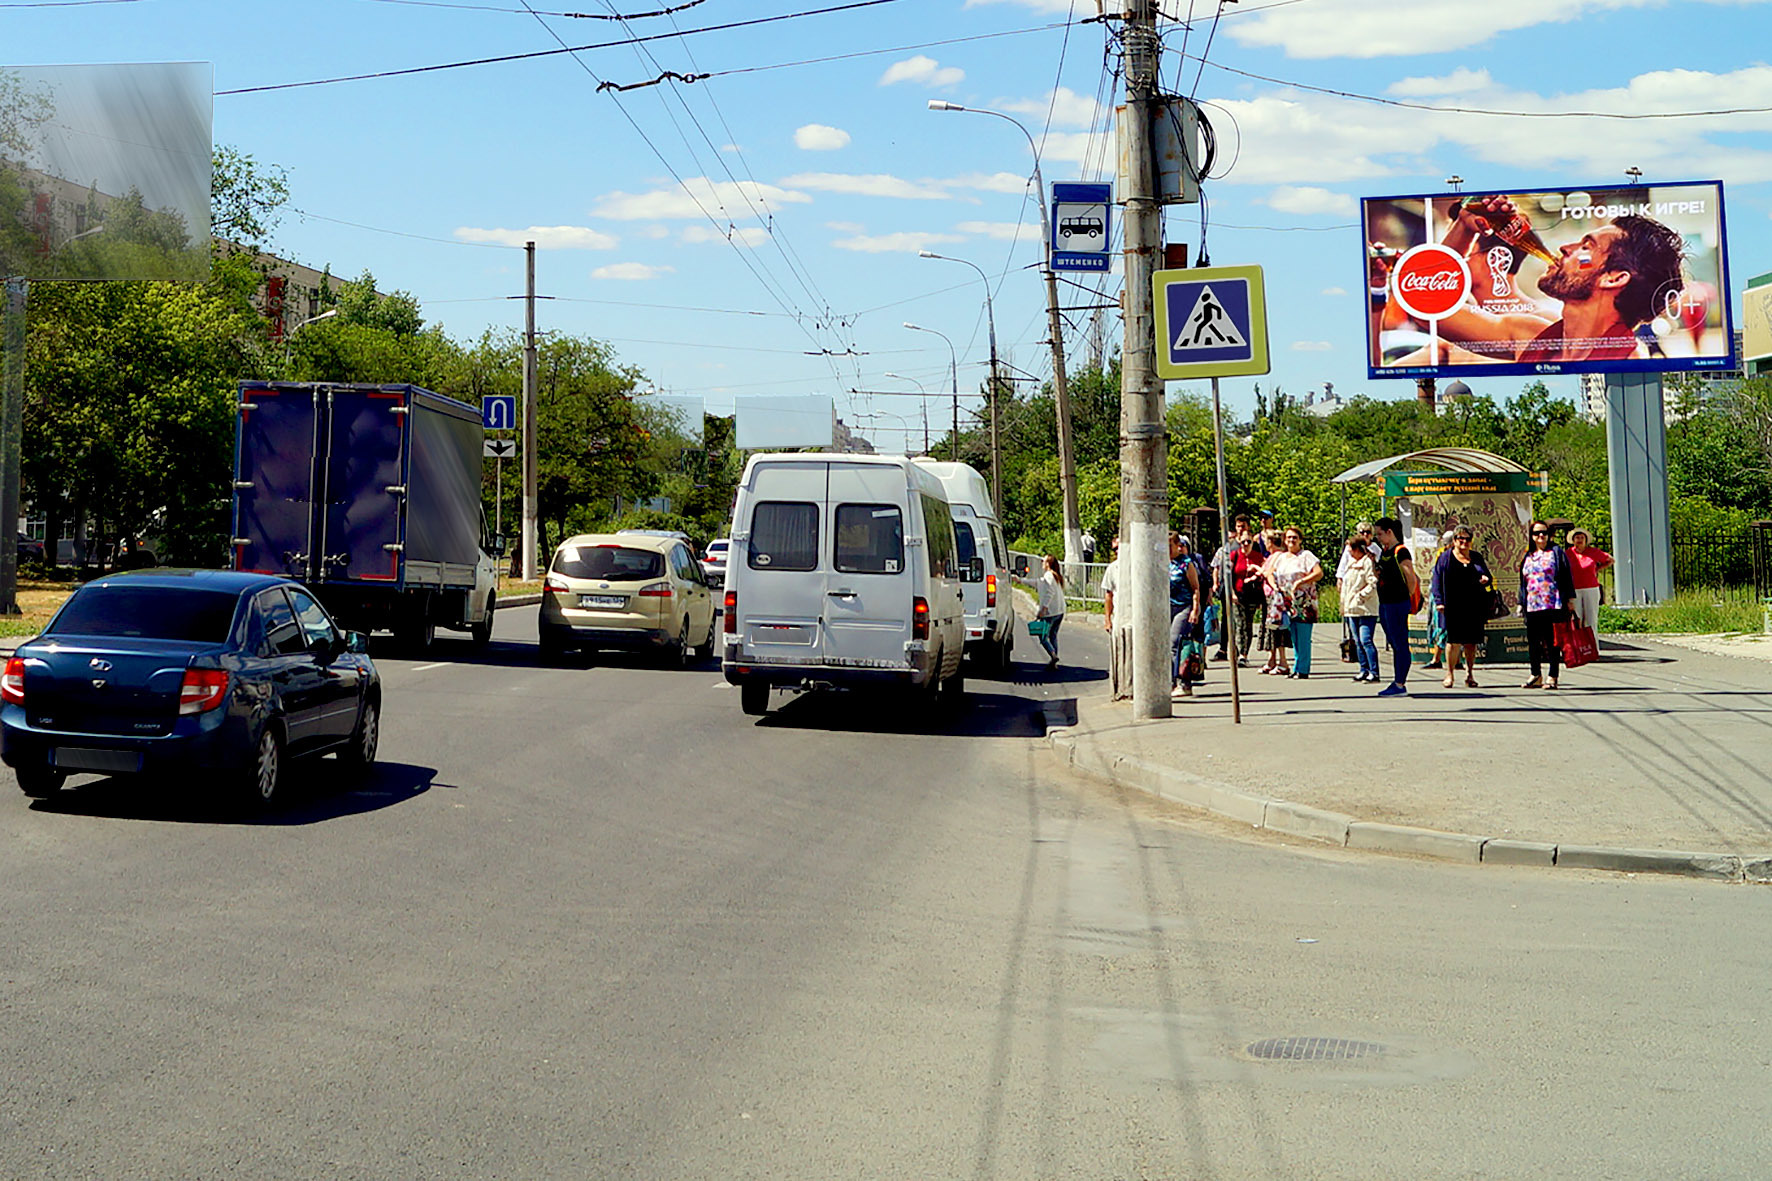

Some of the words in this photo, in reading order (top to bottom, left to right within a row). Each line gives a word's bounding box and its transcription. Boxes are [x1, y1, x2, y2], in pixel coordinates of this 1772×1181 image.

[1561, 204, 1635, 220] ГОТОВЫ
[1639, 203, 1652, 217] К
[1655, 200, 1705, 216] ИГРЕ!
[1057, 258, 1104, 267] ШТЕМЕНКО
[1401, 270, 1462, 292] Coca-Cola
[1470, 304, 1509, 314] RUSSIA
[1510, 303, 1534, 313] 2018
[1664, 289, 1702, 320] 0+
